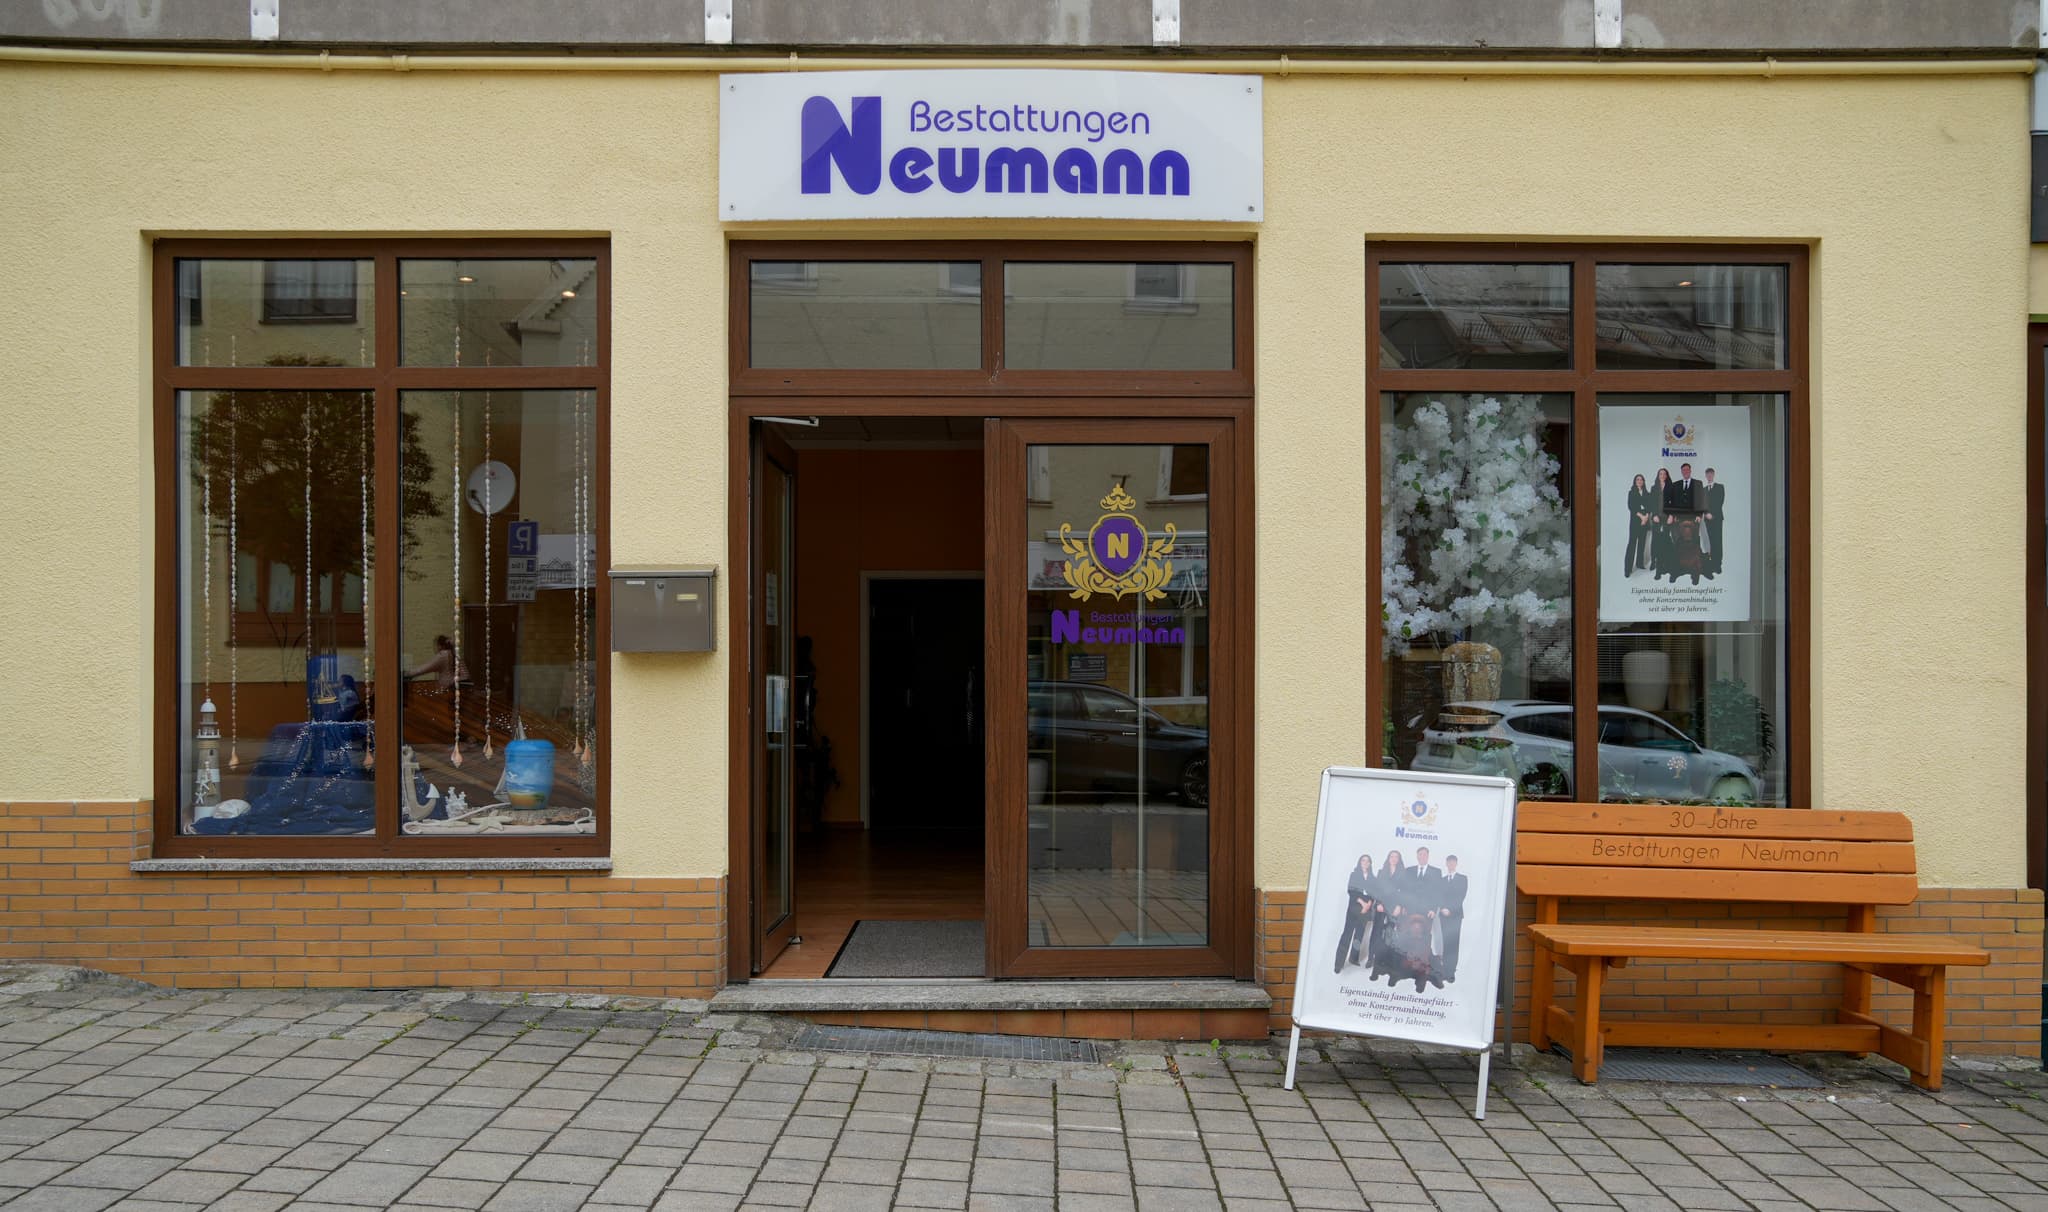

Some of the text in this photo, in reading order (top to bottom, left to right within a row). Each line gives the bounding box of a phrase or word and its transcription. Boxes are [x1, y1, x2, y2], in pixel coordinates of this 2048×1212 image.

[910, 100, 1151, 143] Bestattungen
[800, 95, 1191, 196] Neumann
[1661, 447, 1698, 458] Neumann
[1107, 532, 1129, 559] N
[1631, 587, 1672, 596] Eigenständig
[1672, 586, 1723, 596] familiengeführt
[1051, 609, 1186, 644] Neumann
[1091, 612, 1174, 626] Bestattungen
[1669, 811, 1758, 831] 30 Jahre
[1395, 826, 1439, 841] Neumann
[1591, 838, 1840, 864] Bestattungen Neumann
[1339, 985, 1390, 1001] Eigenständig
[1390, 991, 1454, 1008] familiengeführt
[1347, 998, 1447, 1019] ohne Konzernanbindung,
[1358, 1011, 1374, 1020] seit
[1374, 1012, 1392, 1022] über
[1405, 1016, 1435, 1028] Jahren.
